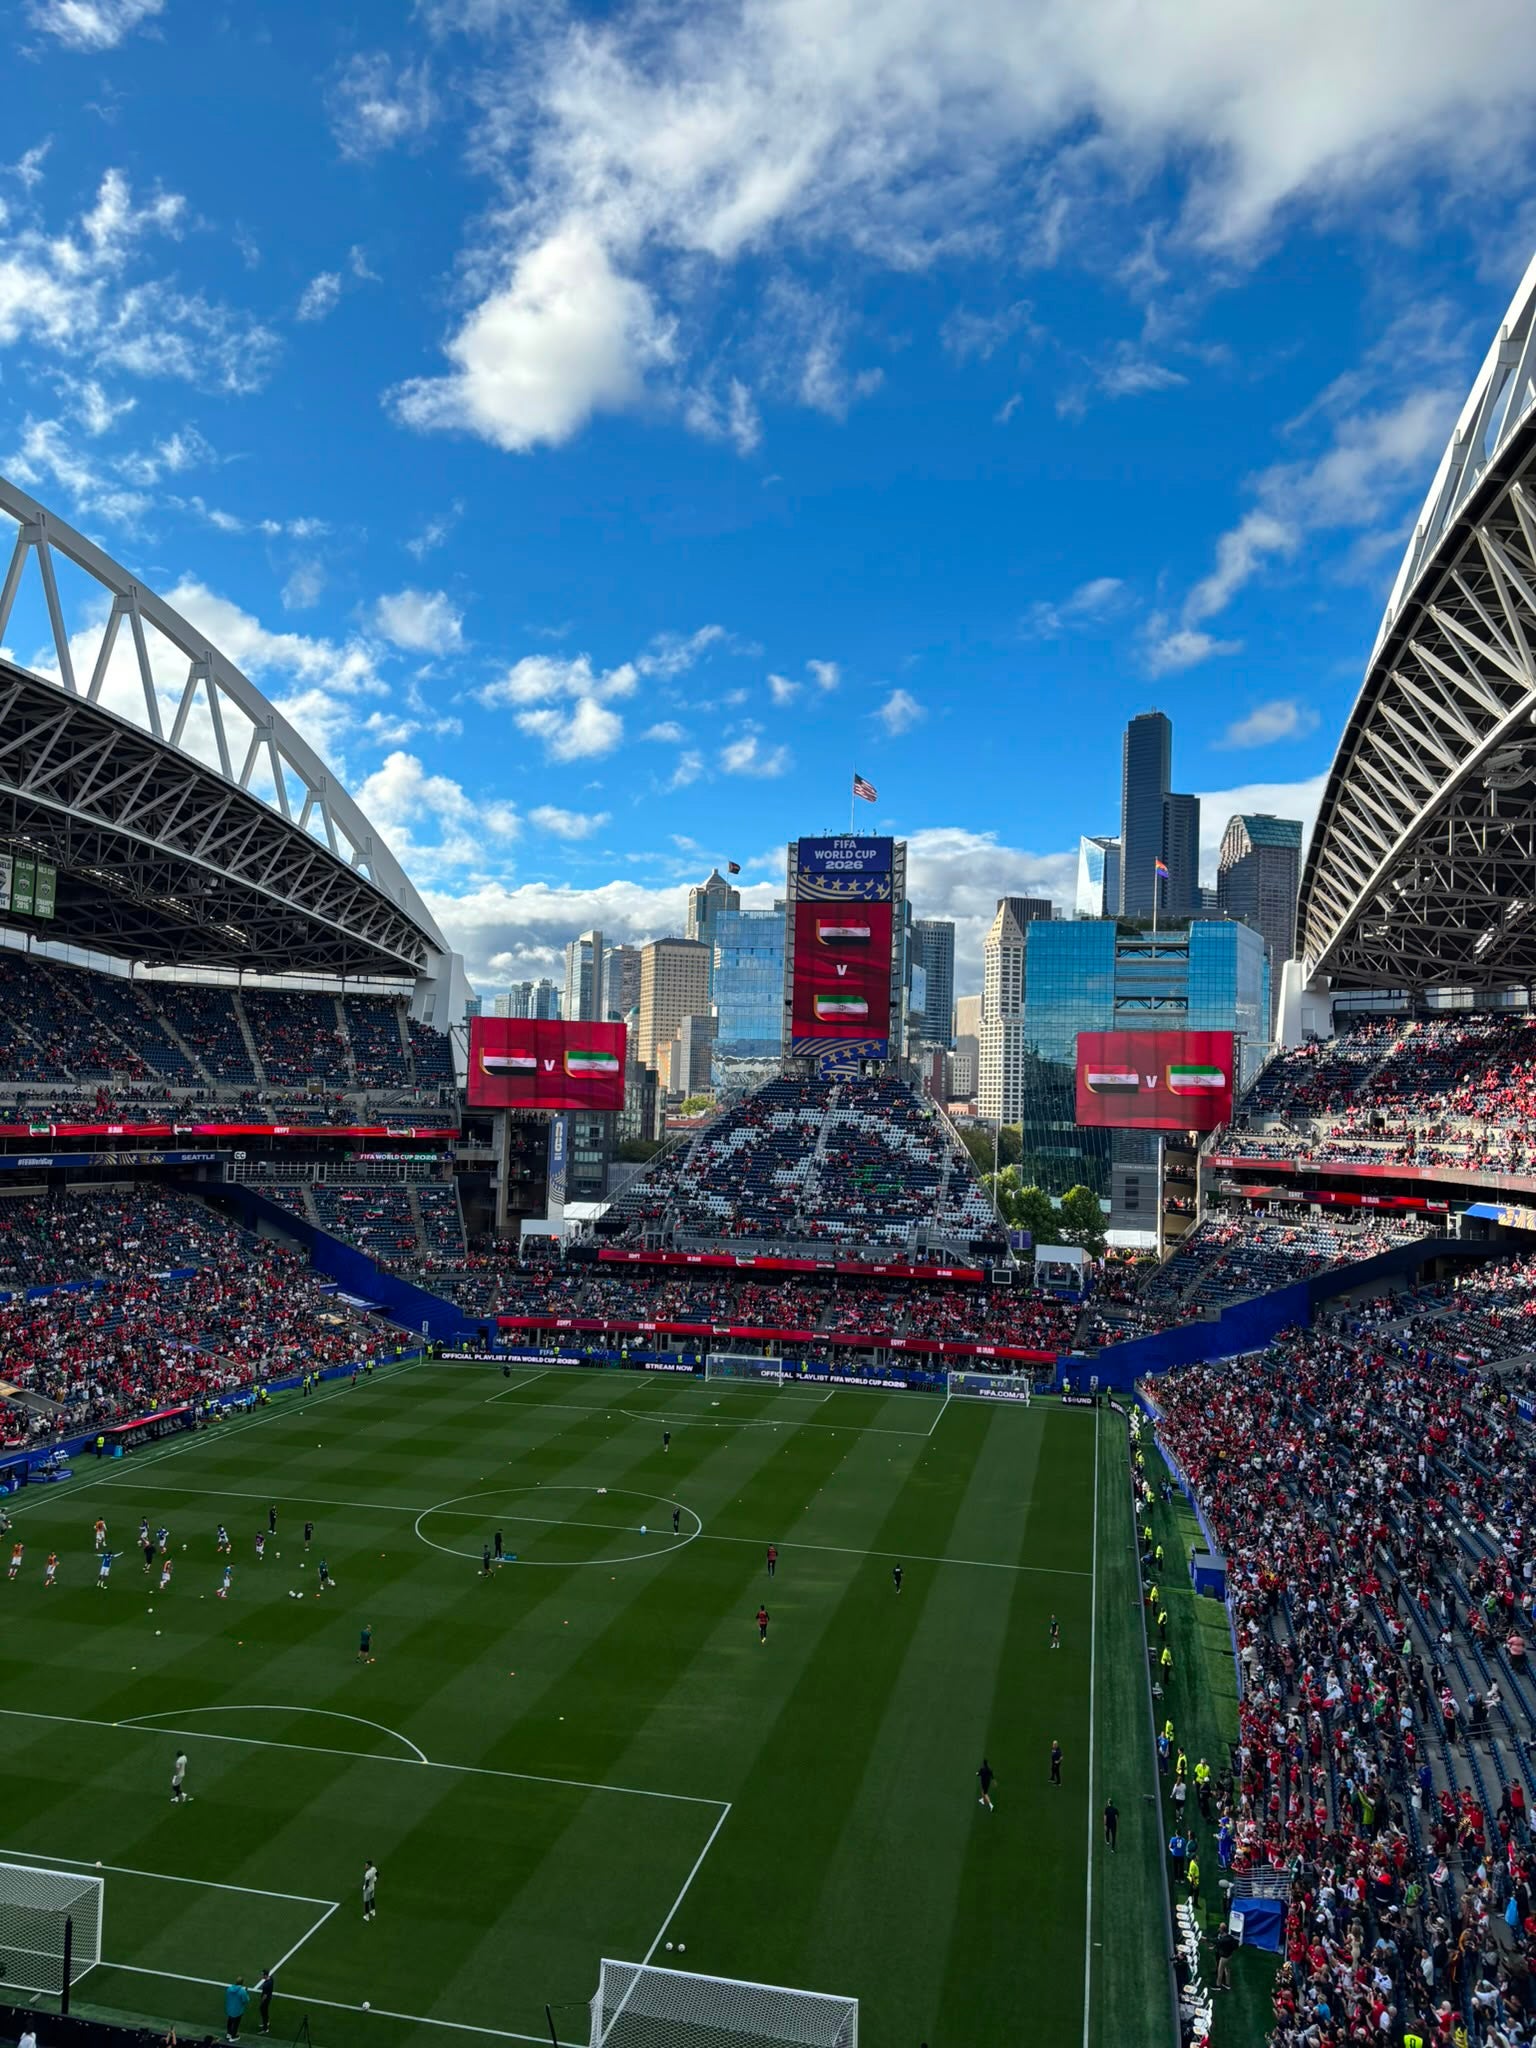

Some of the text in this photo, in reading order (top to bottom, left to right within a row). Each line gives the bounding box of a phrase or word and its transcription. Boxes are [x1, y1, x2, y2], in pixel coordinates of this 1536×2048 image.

[834, 840, 856, 848] FIFA
[815, 850, 876, 860] WORLD CUP
[825, 860, 864, 870] 2026
[761, 1370, 793, 1379] OFFICIAL
